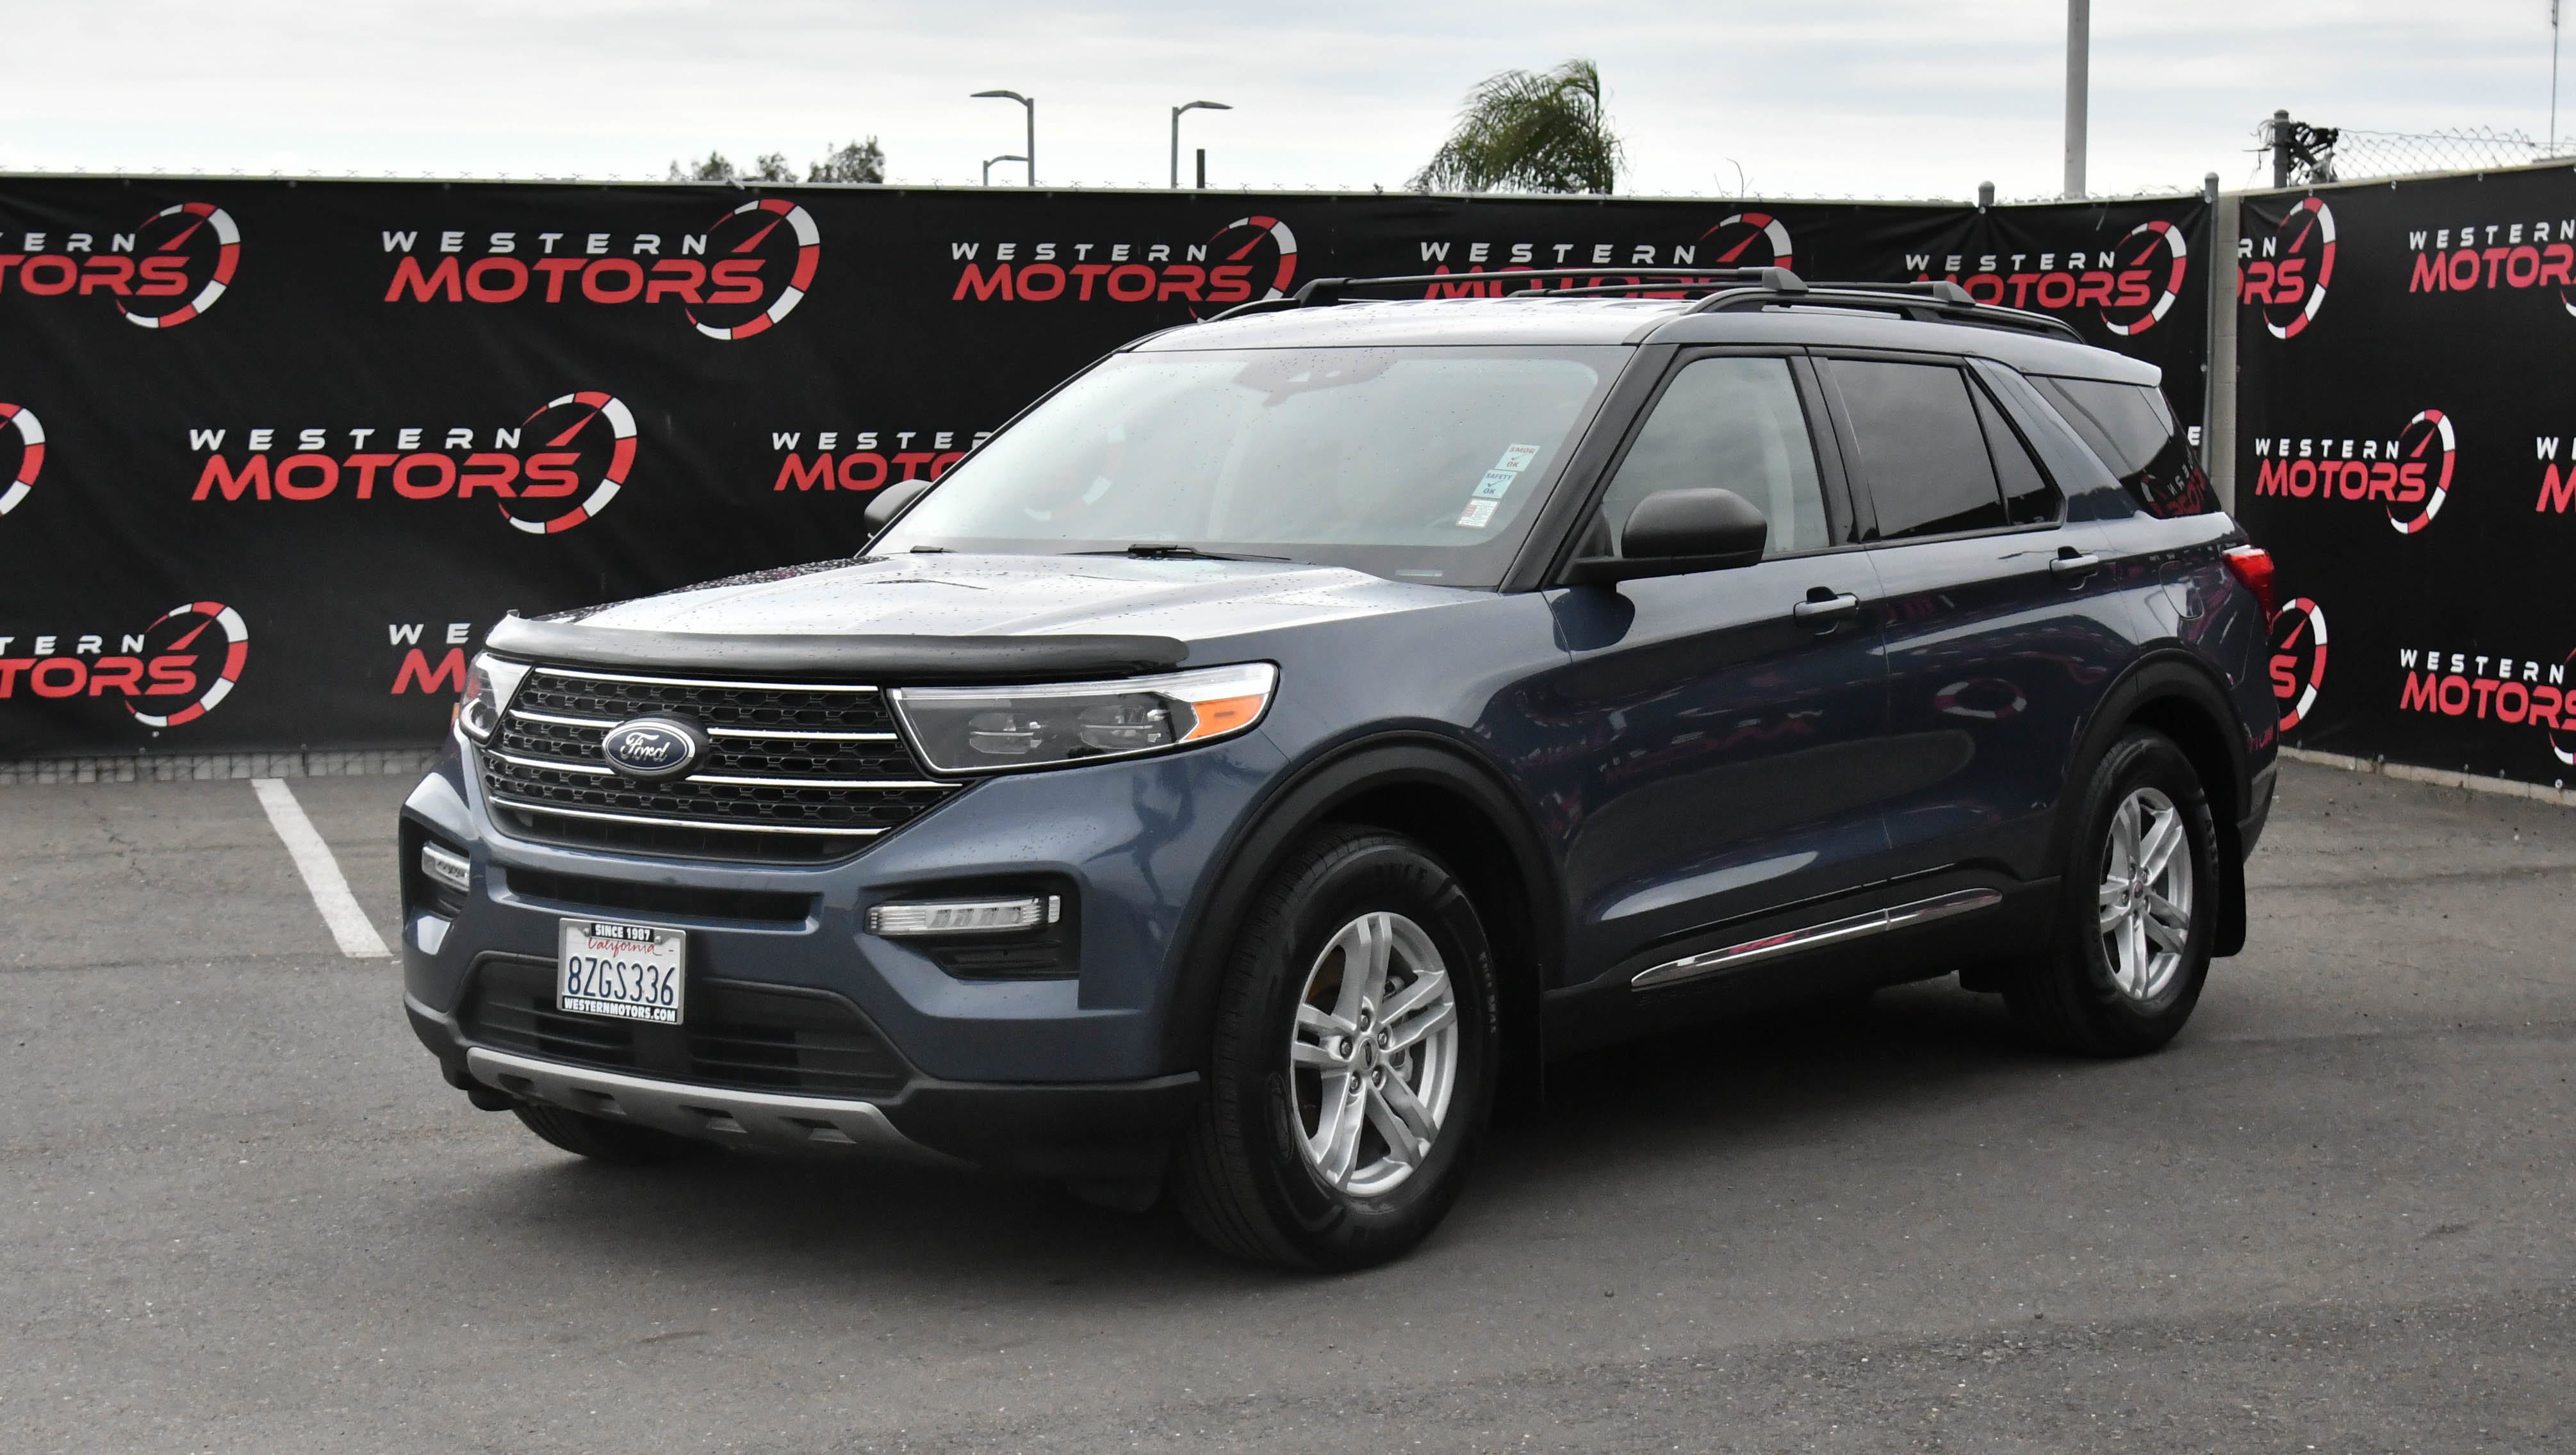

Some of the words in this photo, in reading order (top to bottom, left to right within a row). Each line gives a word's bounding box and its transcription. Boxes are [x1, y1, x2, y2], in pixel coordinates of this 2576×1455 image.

[0, 232, 135, 252] ERN
[382, 231, 707, 255] WESTERN
[2409, 218, 2575, 250] WESTERN
[951, 242, 1207, 262] WESTERN
[1420, 242, 1696, 265] WESTERN
[1905, 252, 2115, 272] WESTERN
[384, 256, 766, 304] MOTORS
[952, 263, 1254, 302] MOTORS
[2409, 243, 2576, 293] MOTOR
[1917, 270, 2151, 308] OTORS
[190, 427, 521, 451] WESTERN
[2255, 438, 2399, 459] WESTERN
[192, 452, 582, 501] MOTORS
[2255, 458, 2428, 502] MOTORS
[2400, 648, 2564, 685] WESTERN
[619, 732, 671, 762] Ford
[595, 924, 623, 939] SINCE
[626, 928, 650, 941] 1987
[568, 956, 675, 1006] 8ZGS336
[564, 997, 676, 1022] WESTERNMOTORS.COM
